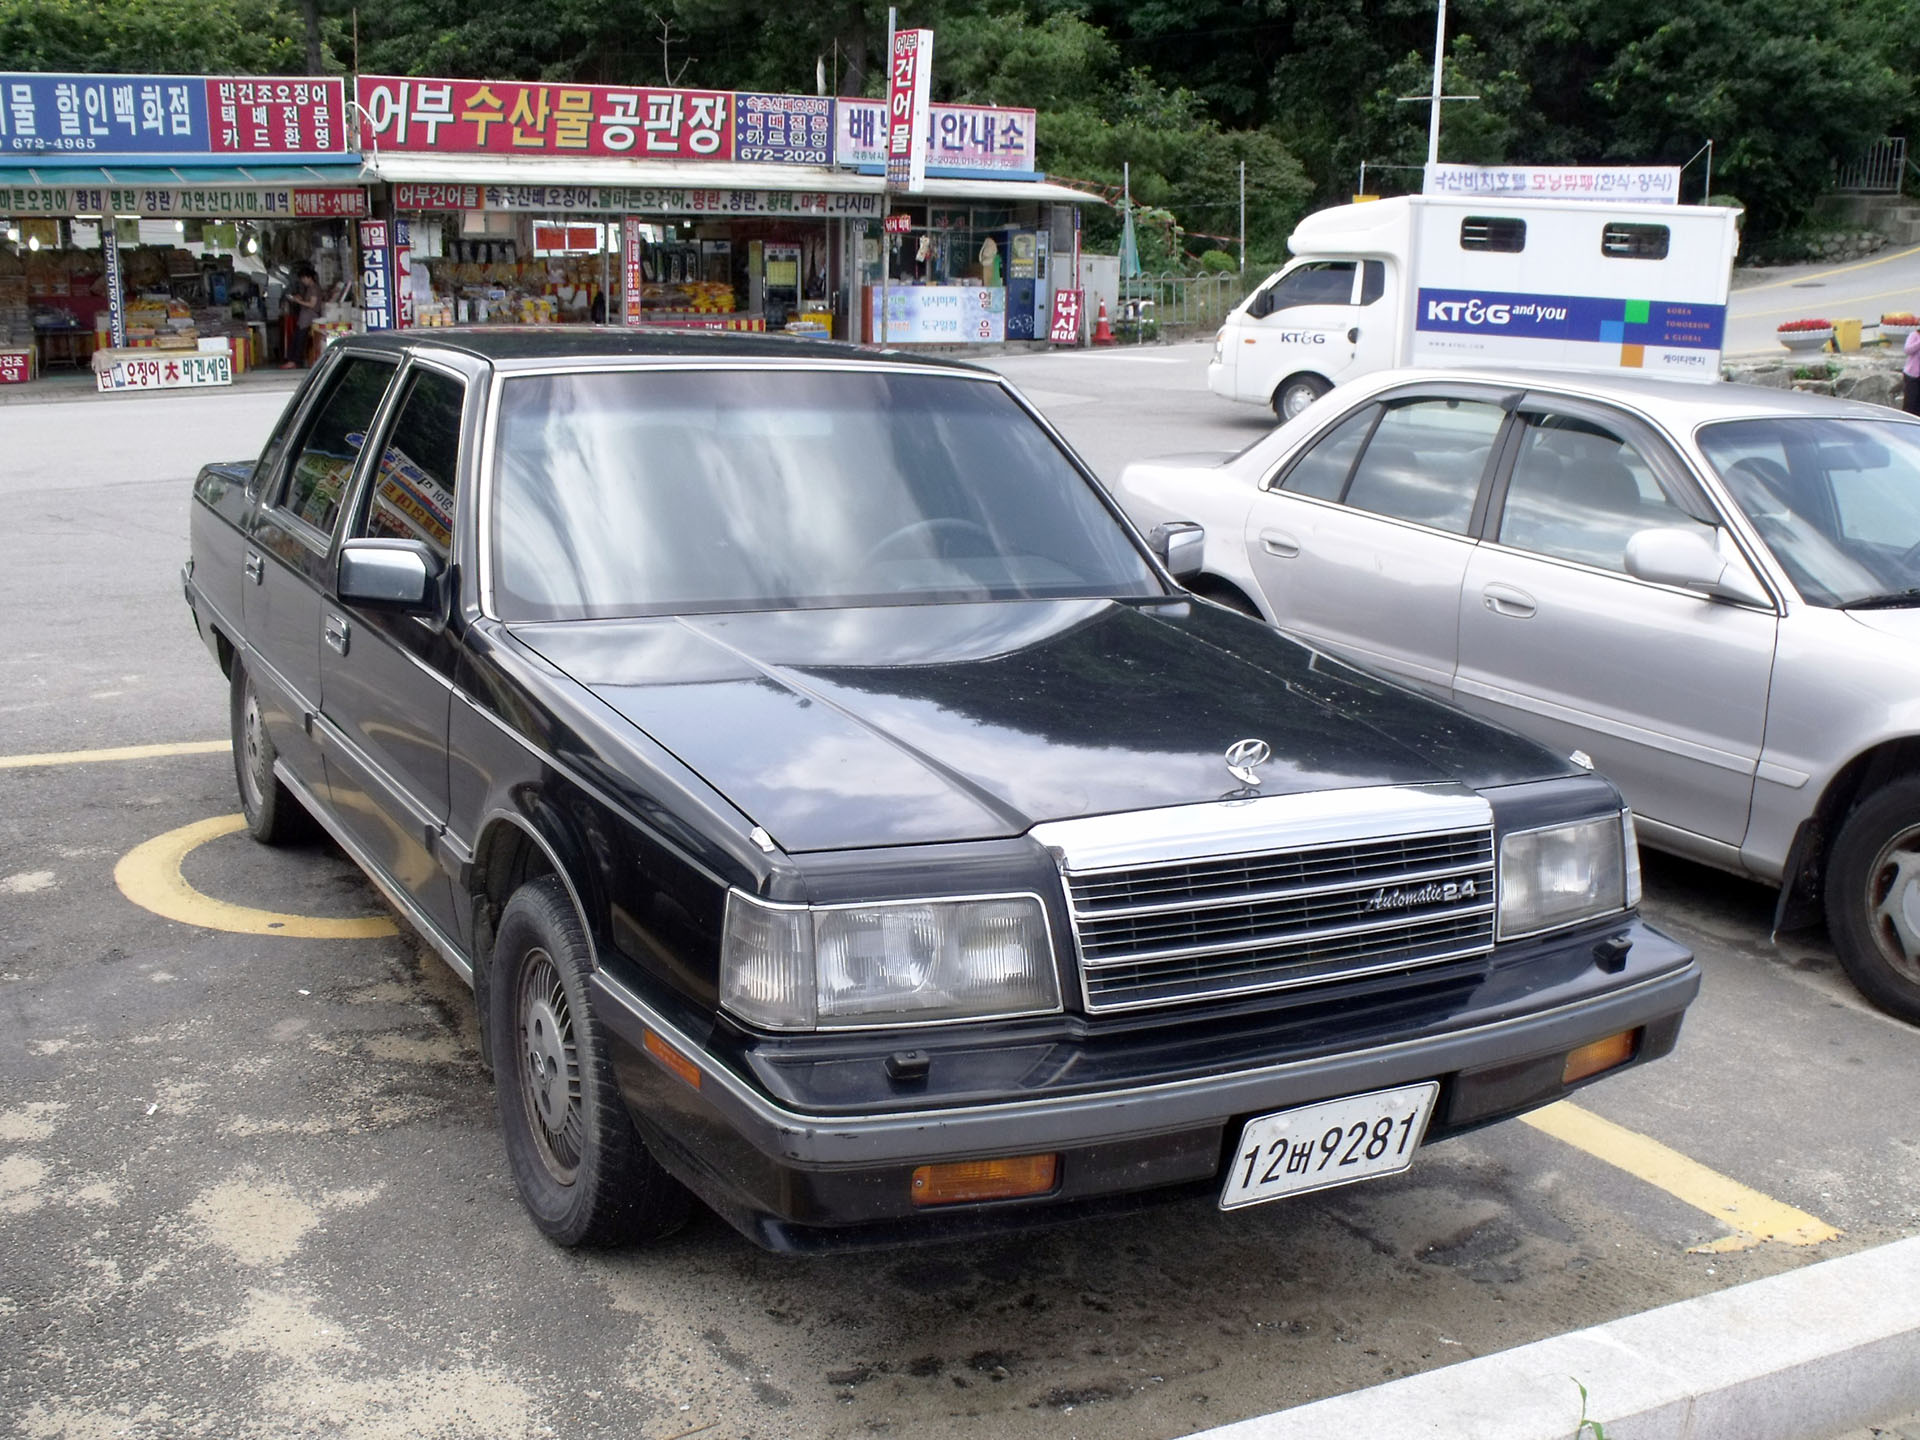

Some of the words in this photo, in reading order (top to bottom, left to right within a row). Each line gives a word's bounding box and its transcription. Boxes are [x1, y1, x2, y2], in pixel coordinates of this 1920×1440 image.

[893, 35, 917, 56] 어부
[218, 82, 329, 106] 반건조오징어
[746, 96, 829, 116] 속초산배오징어
[890, 56, 915, 154] 건어물
[54, 83, 192, 136] 할인백화점
[12, 137, 97, 150] 672-4965
[740, 148, 827, 163] 672-2020
[399, 184, 479, 208] 어부건어물
[1428, 299, 1511, 325] KT&G
[1512, 304, 1536, 316] and
[1536, 306, 1567, 323] you
[1281, 331, 1326, 345] KT&G
[127, 361, 161, 386] 오징어
[182, 357, 229, 383] 바겐세일
[1365, 884, 1443, 912] Automatic
[1443, 879, 1477, 901] 2.4
[1241, 1110, 1417, 1189] 12버9281
